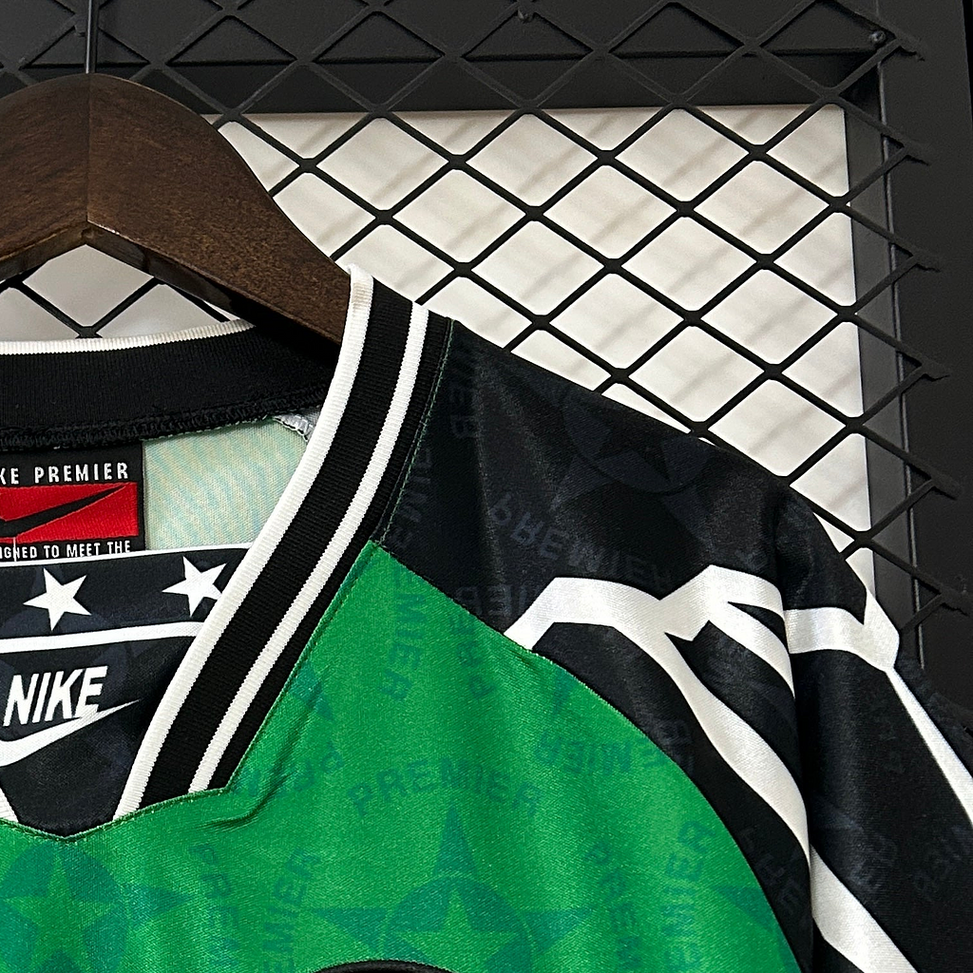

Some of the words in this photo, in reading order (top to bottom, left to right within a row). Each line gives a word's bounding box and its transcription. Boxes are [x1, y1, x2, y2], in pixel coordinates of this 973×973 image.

[34, 462, 129, 483] PREMIER
[42, 543, 60, 558] TO
[65, 542, 103, 558] MEET
[107, 540, 132, 555] THE
[2, 665, 109, 727] NIKE
[348, 755, 545, 817] PREMIER
